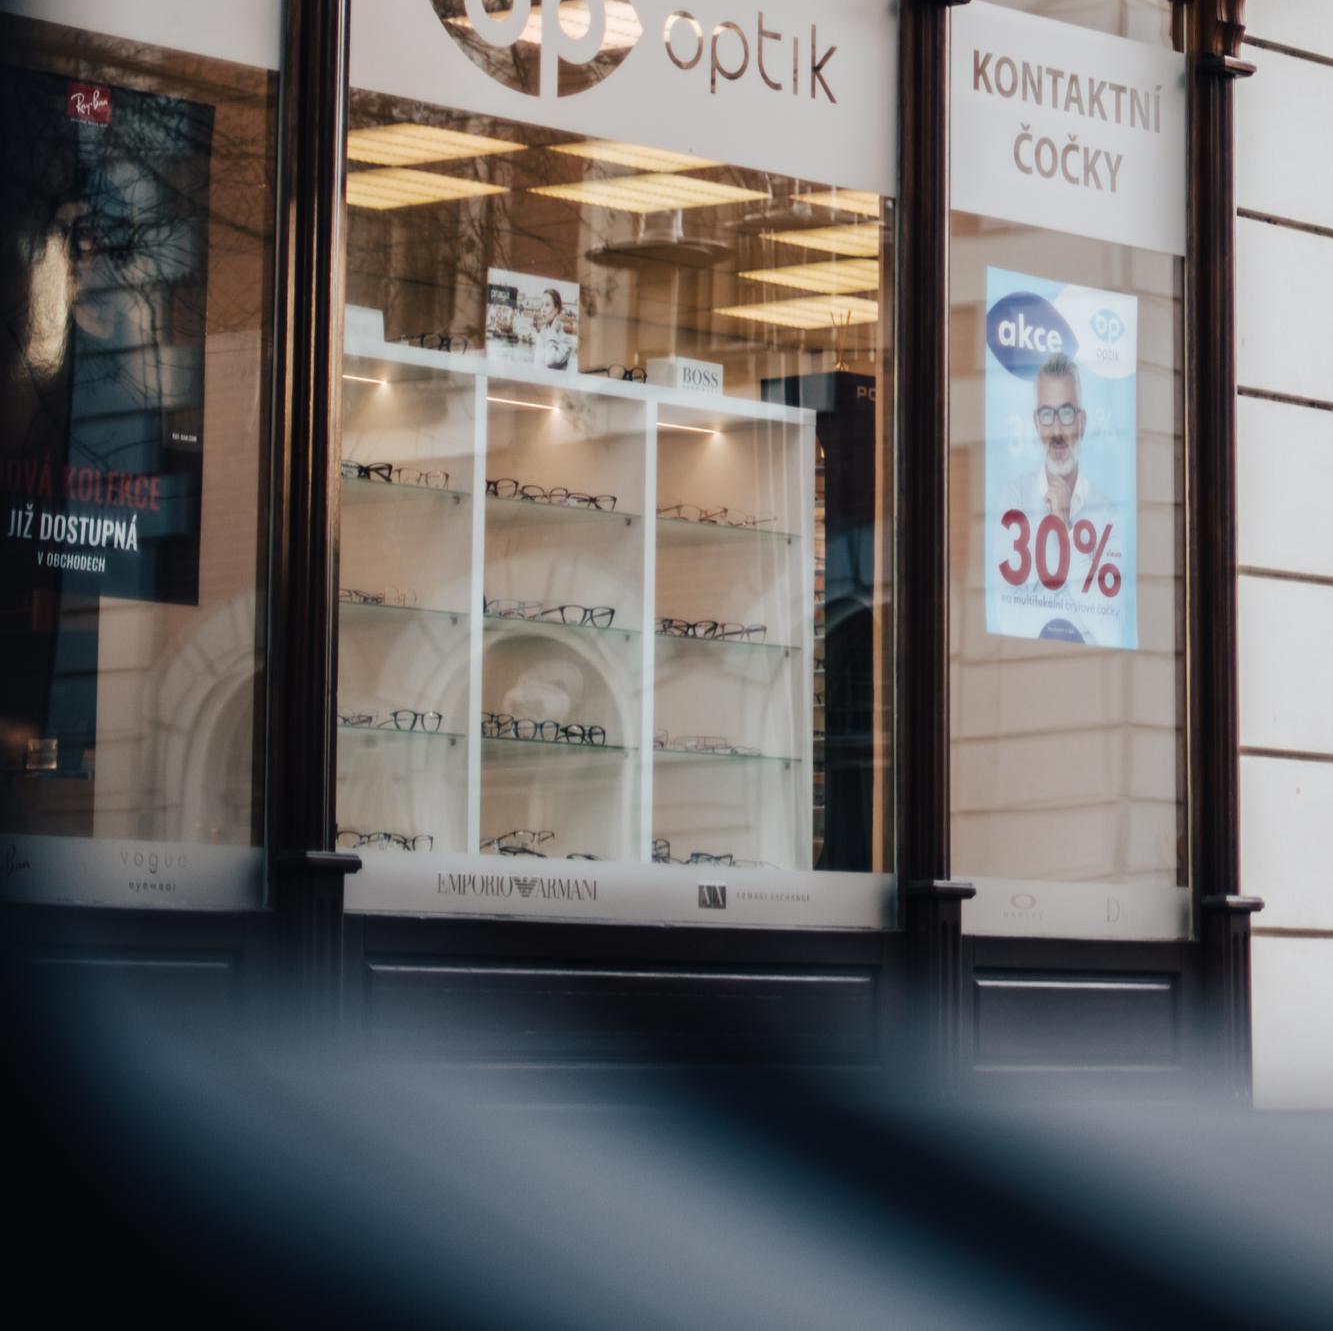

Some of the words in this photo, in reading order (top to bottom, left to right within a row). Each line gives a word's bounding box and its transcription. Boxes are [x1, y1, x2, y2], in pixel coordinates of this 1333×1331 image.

[663, 10, 837, 104] optik
[972, 49, 1163, 134] KONTAKTNÍ
[1013, 122, 1124, 194] ČOČKY
[998, 312, 1063, 352] akce
[682, 366, 719, 388] BOSS
[64, 464, 161, 511] KOLEKCE
[8, 502, 34, 539] JIŽ
[39, 512, 139, 552] DOSTUPNÁ
[37, 551, 43, 566] V
[46, 552, 106, 573] OBCHODECH
[998, 508, 1122, 598] 30%
[437, 873, 514, 898] EMPORIO
[535, 877, 598, 902] ARMANI
